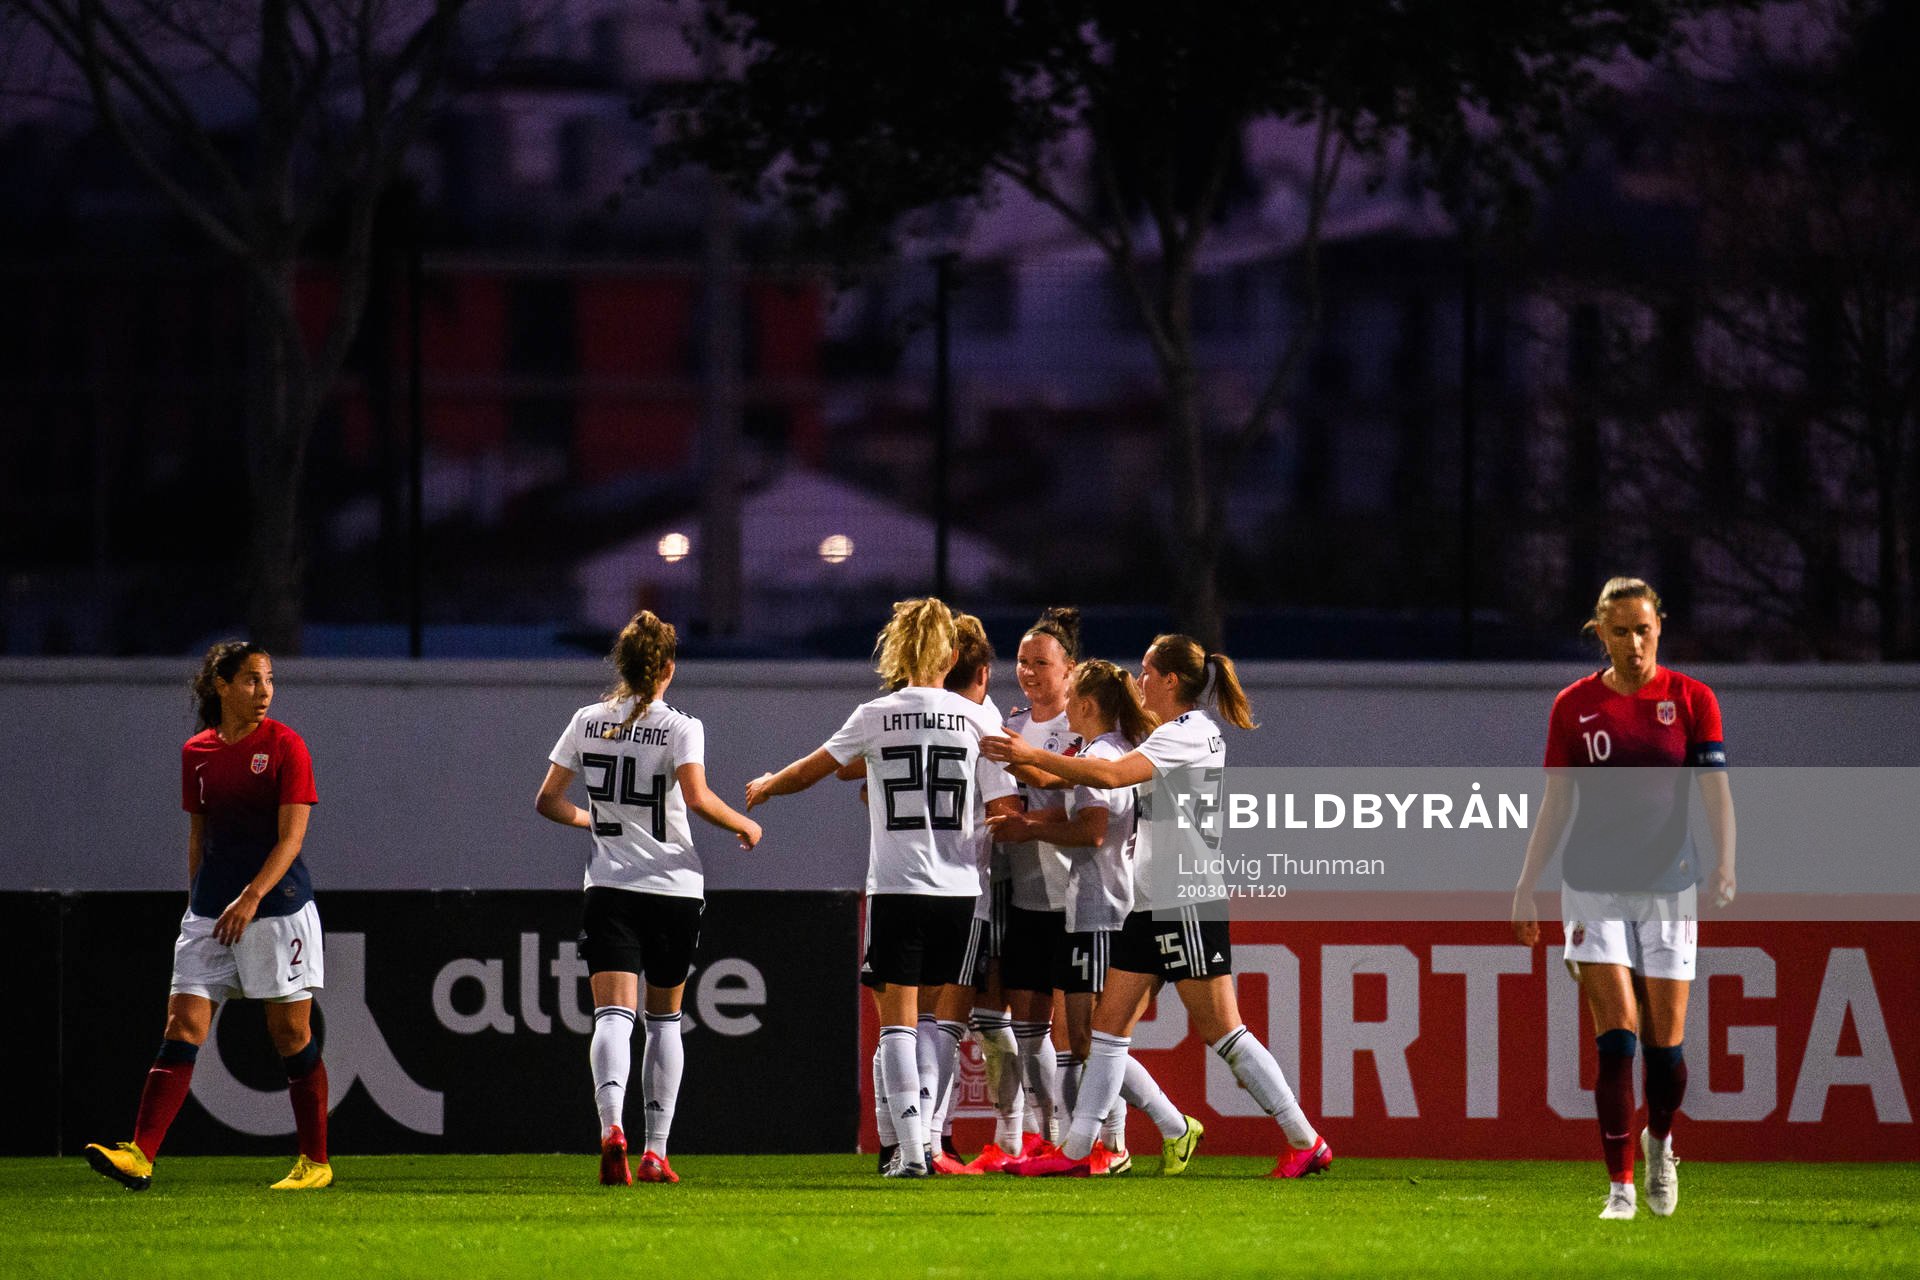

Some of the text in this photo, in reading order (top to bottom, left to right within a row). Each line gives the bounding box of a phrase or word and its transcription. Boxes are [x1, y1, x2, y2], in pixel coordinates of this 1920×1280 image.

[884, 713, 965, 732] LATTWEIN
[1583, 730, 1611, 763] 10
[582, 752, 667, 843] 24
[881, 745, 968, 831] 26
[290, 938, 302, 965] 2
[432, 932, 767, 1035] alte
